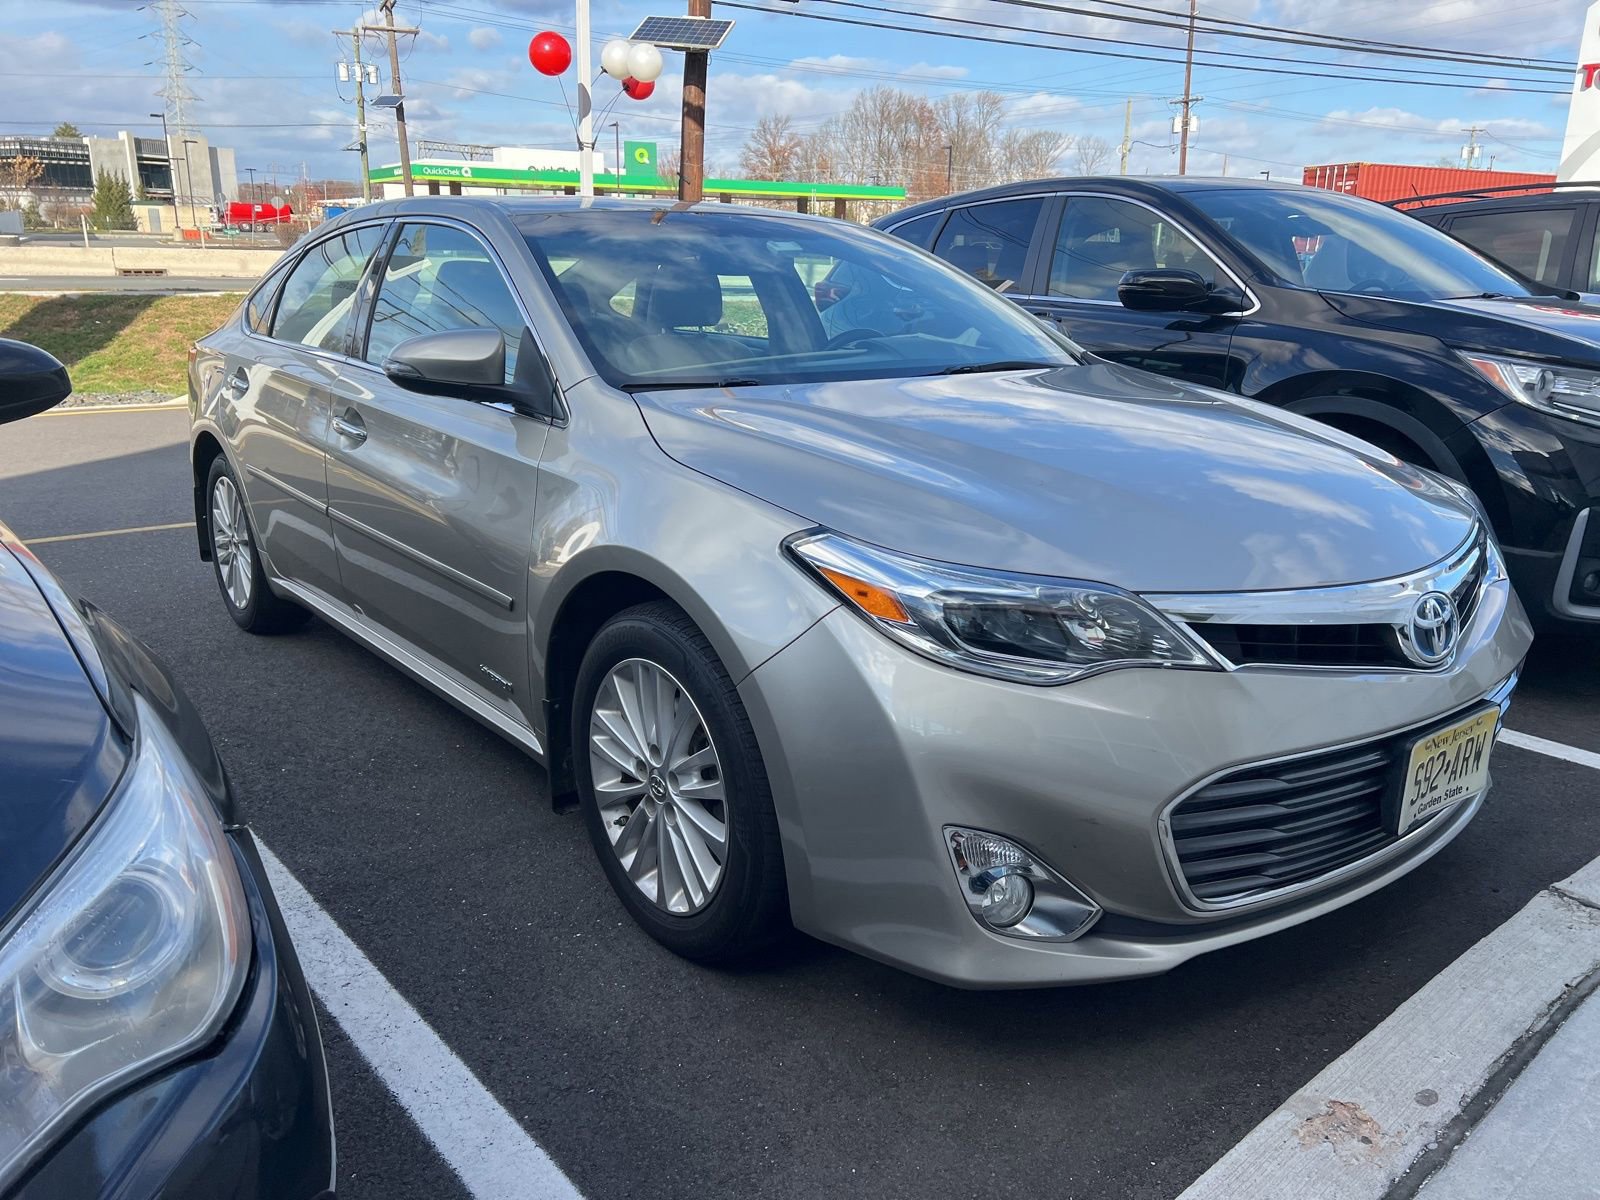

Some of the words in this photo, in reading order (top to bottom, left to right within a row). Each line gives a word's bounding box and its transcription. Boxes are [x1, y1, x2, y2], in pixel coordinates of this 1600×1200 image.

[422, 166, 461, 176] QuickChek
[1430, 736, 1449, 750] New
[1449, 725, 1474, 746] Jersey
[1417, 795, 1442, 814] Garden
[1444, 785, 1463, 800] State
